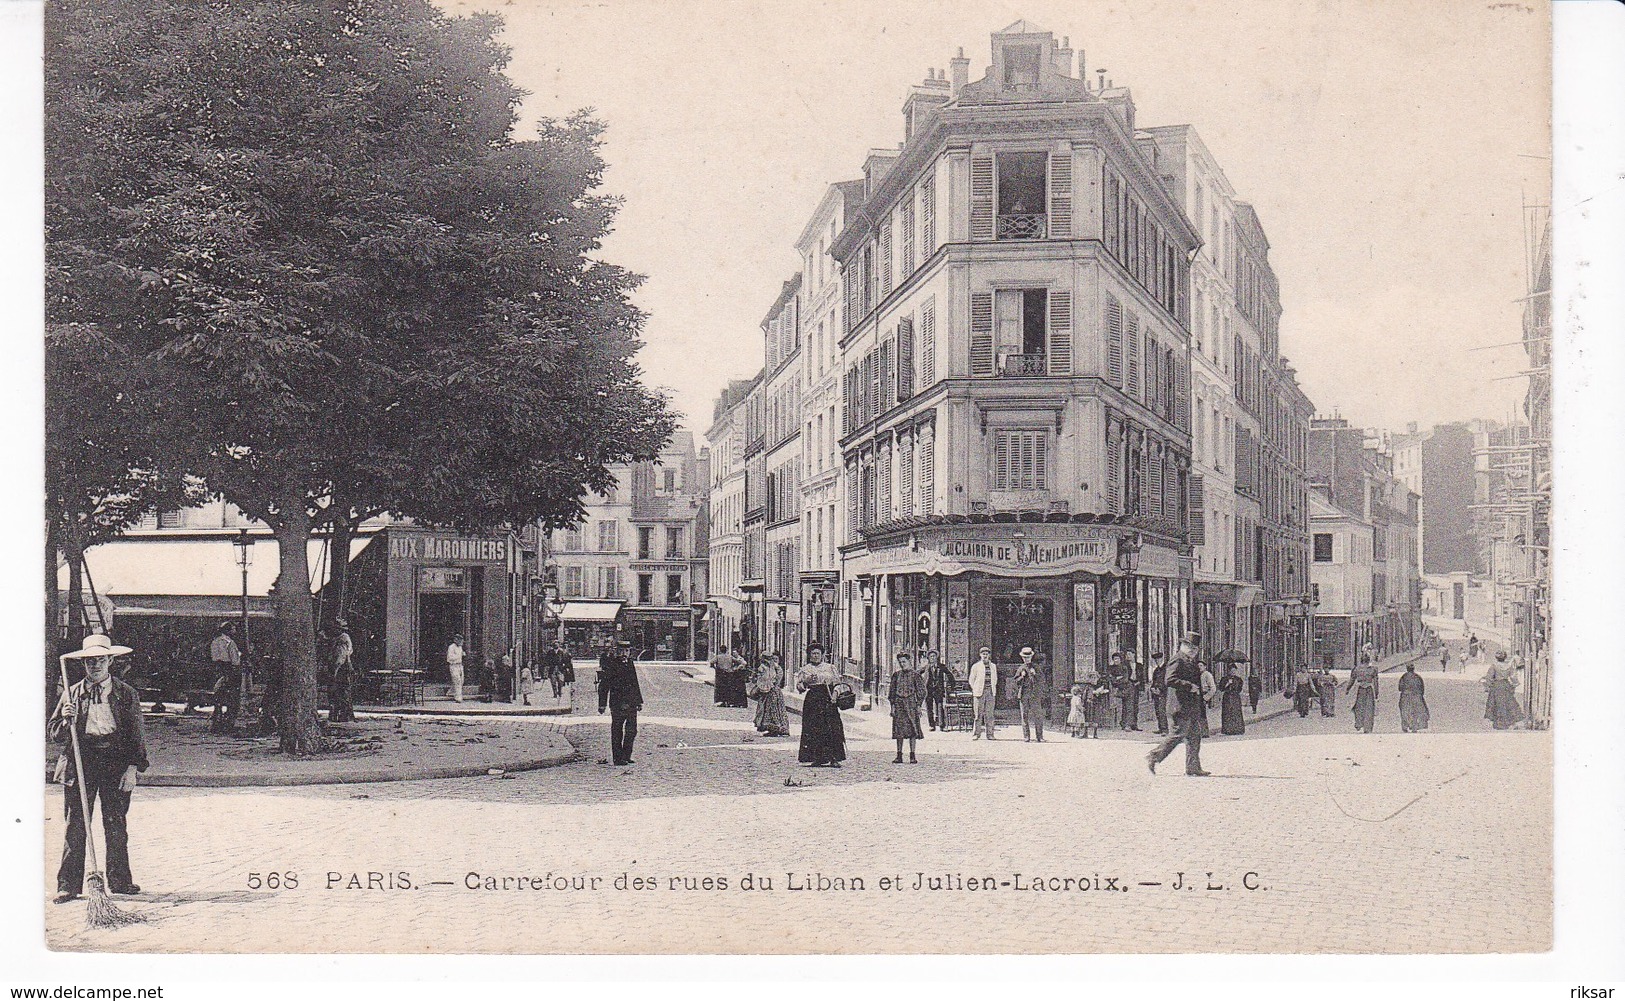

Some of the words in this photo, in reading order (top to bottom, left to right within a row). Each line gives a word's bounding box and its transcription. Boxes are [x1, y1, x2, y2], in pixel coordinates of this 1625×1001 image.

[390, 538, 418, 559] AUX
[423, 537, 505, 560] MARONNIERS
[945, 543, 955, 557] AU
[955, 541, 994, 559] CLAIRON
[997, 546, 1011, 561] DE
